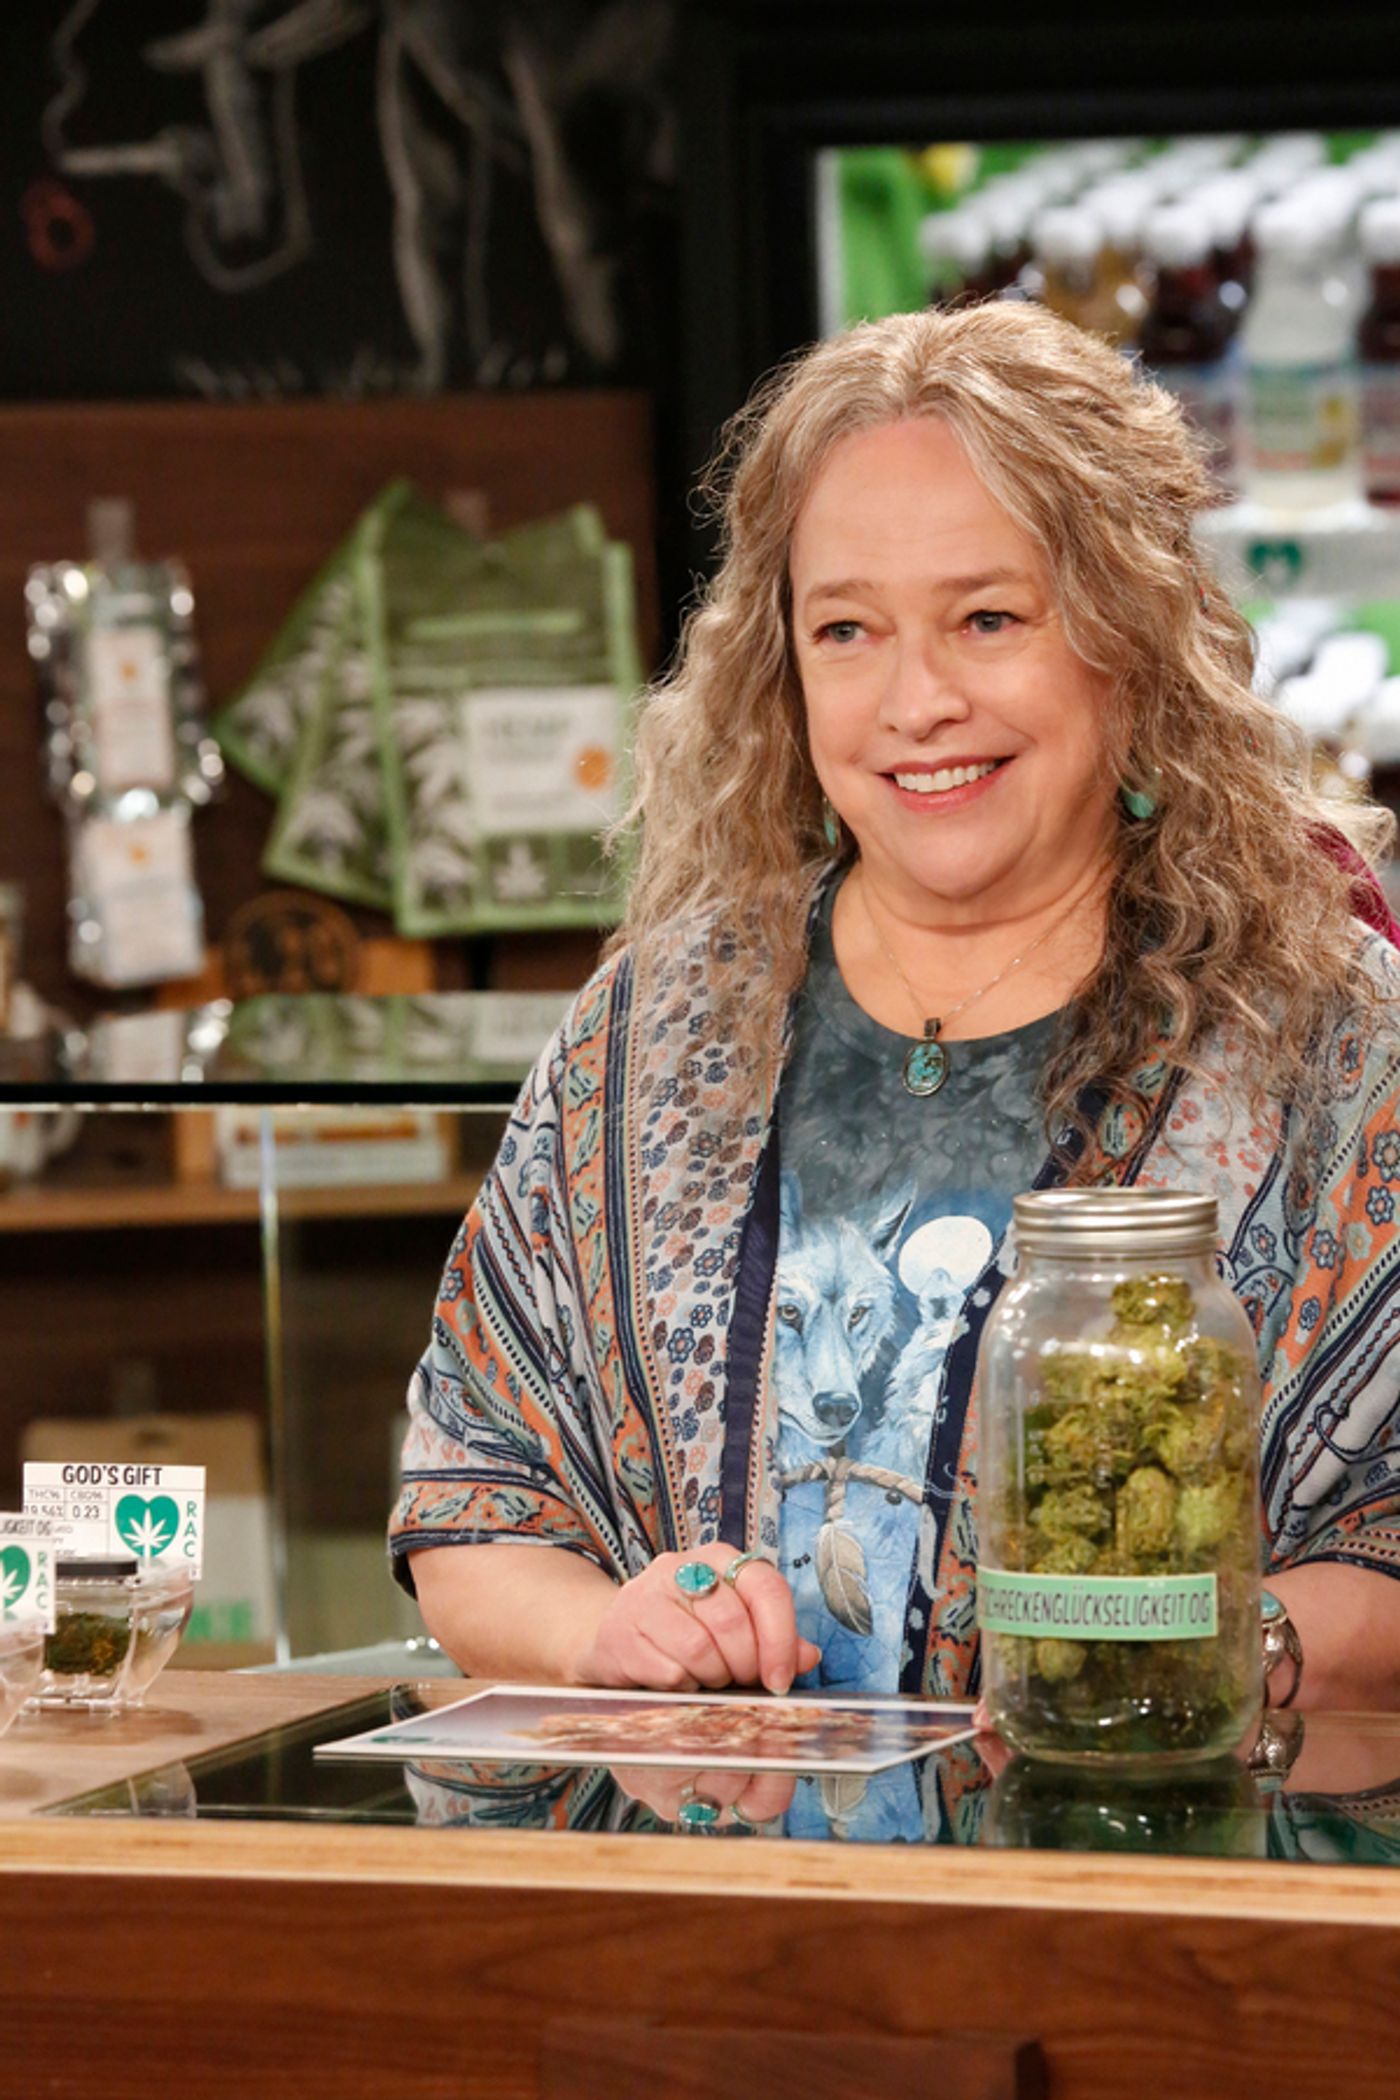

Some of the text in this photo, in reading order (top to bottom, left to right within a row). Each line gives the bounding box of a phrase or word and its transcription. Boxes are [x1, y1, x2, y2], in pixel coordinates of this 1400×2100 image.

[62, 1465, 163, 1486] GOD'S GIFT
[1190, 1592, 1212, 1624] OG
